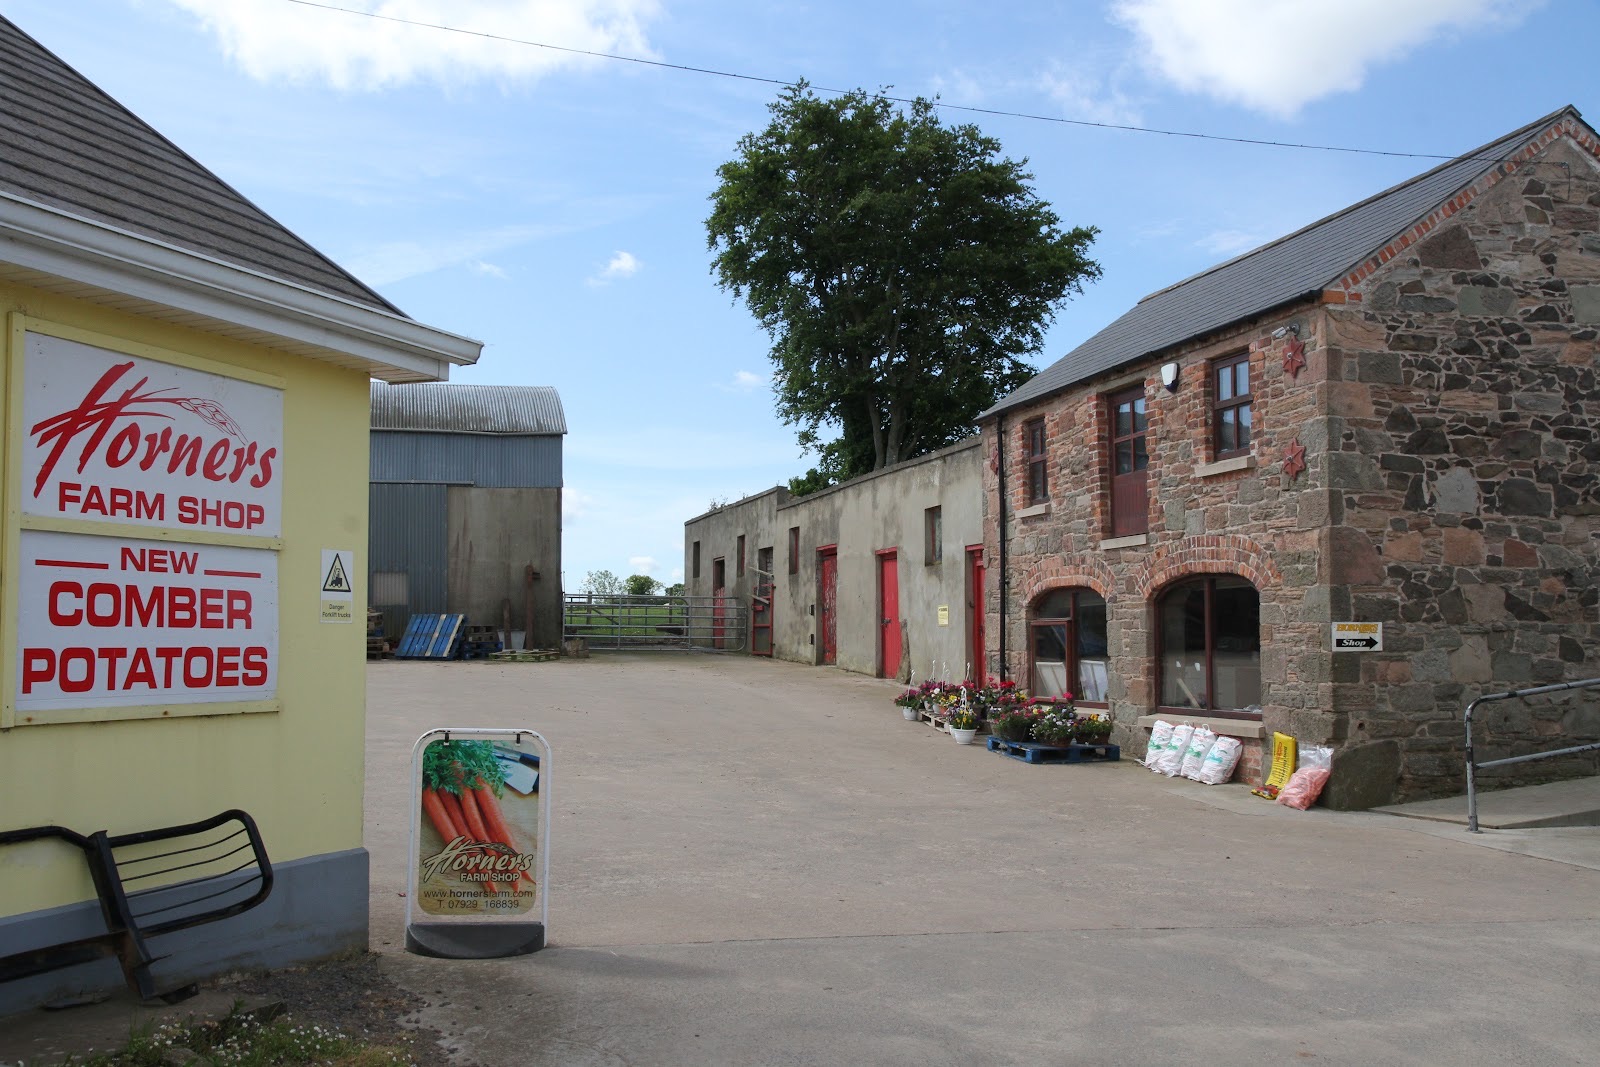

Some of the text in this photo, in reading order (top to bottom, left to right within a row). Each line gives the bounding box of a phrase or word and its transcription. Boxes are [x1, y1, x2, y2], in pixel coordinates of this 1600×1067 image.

[30, 361, 277, 499] Horners
[58, 481, 265, 530] FARM SHOP
[120, 547, 199, 575] NEW
[48, 580, 253, 630] COMBER
[1341, 639, 1367, 647] Shop
[22, 646, 268, 694] POTATOES
[422, 835, 534, 883] Horners
[460, 872, 520, 882] FARM SHOP
[423, 889, 533, 898] www.hornersfarm.com
[448, 899, 478, 909] 07929
[485, 899, 520, 909] 168839
